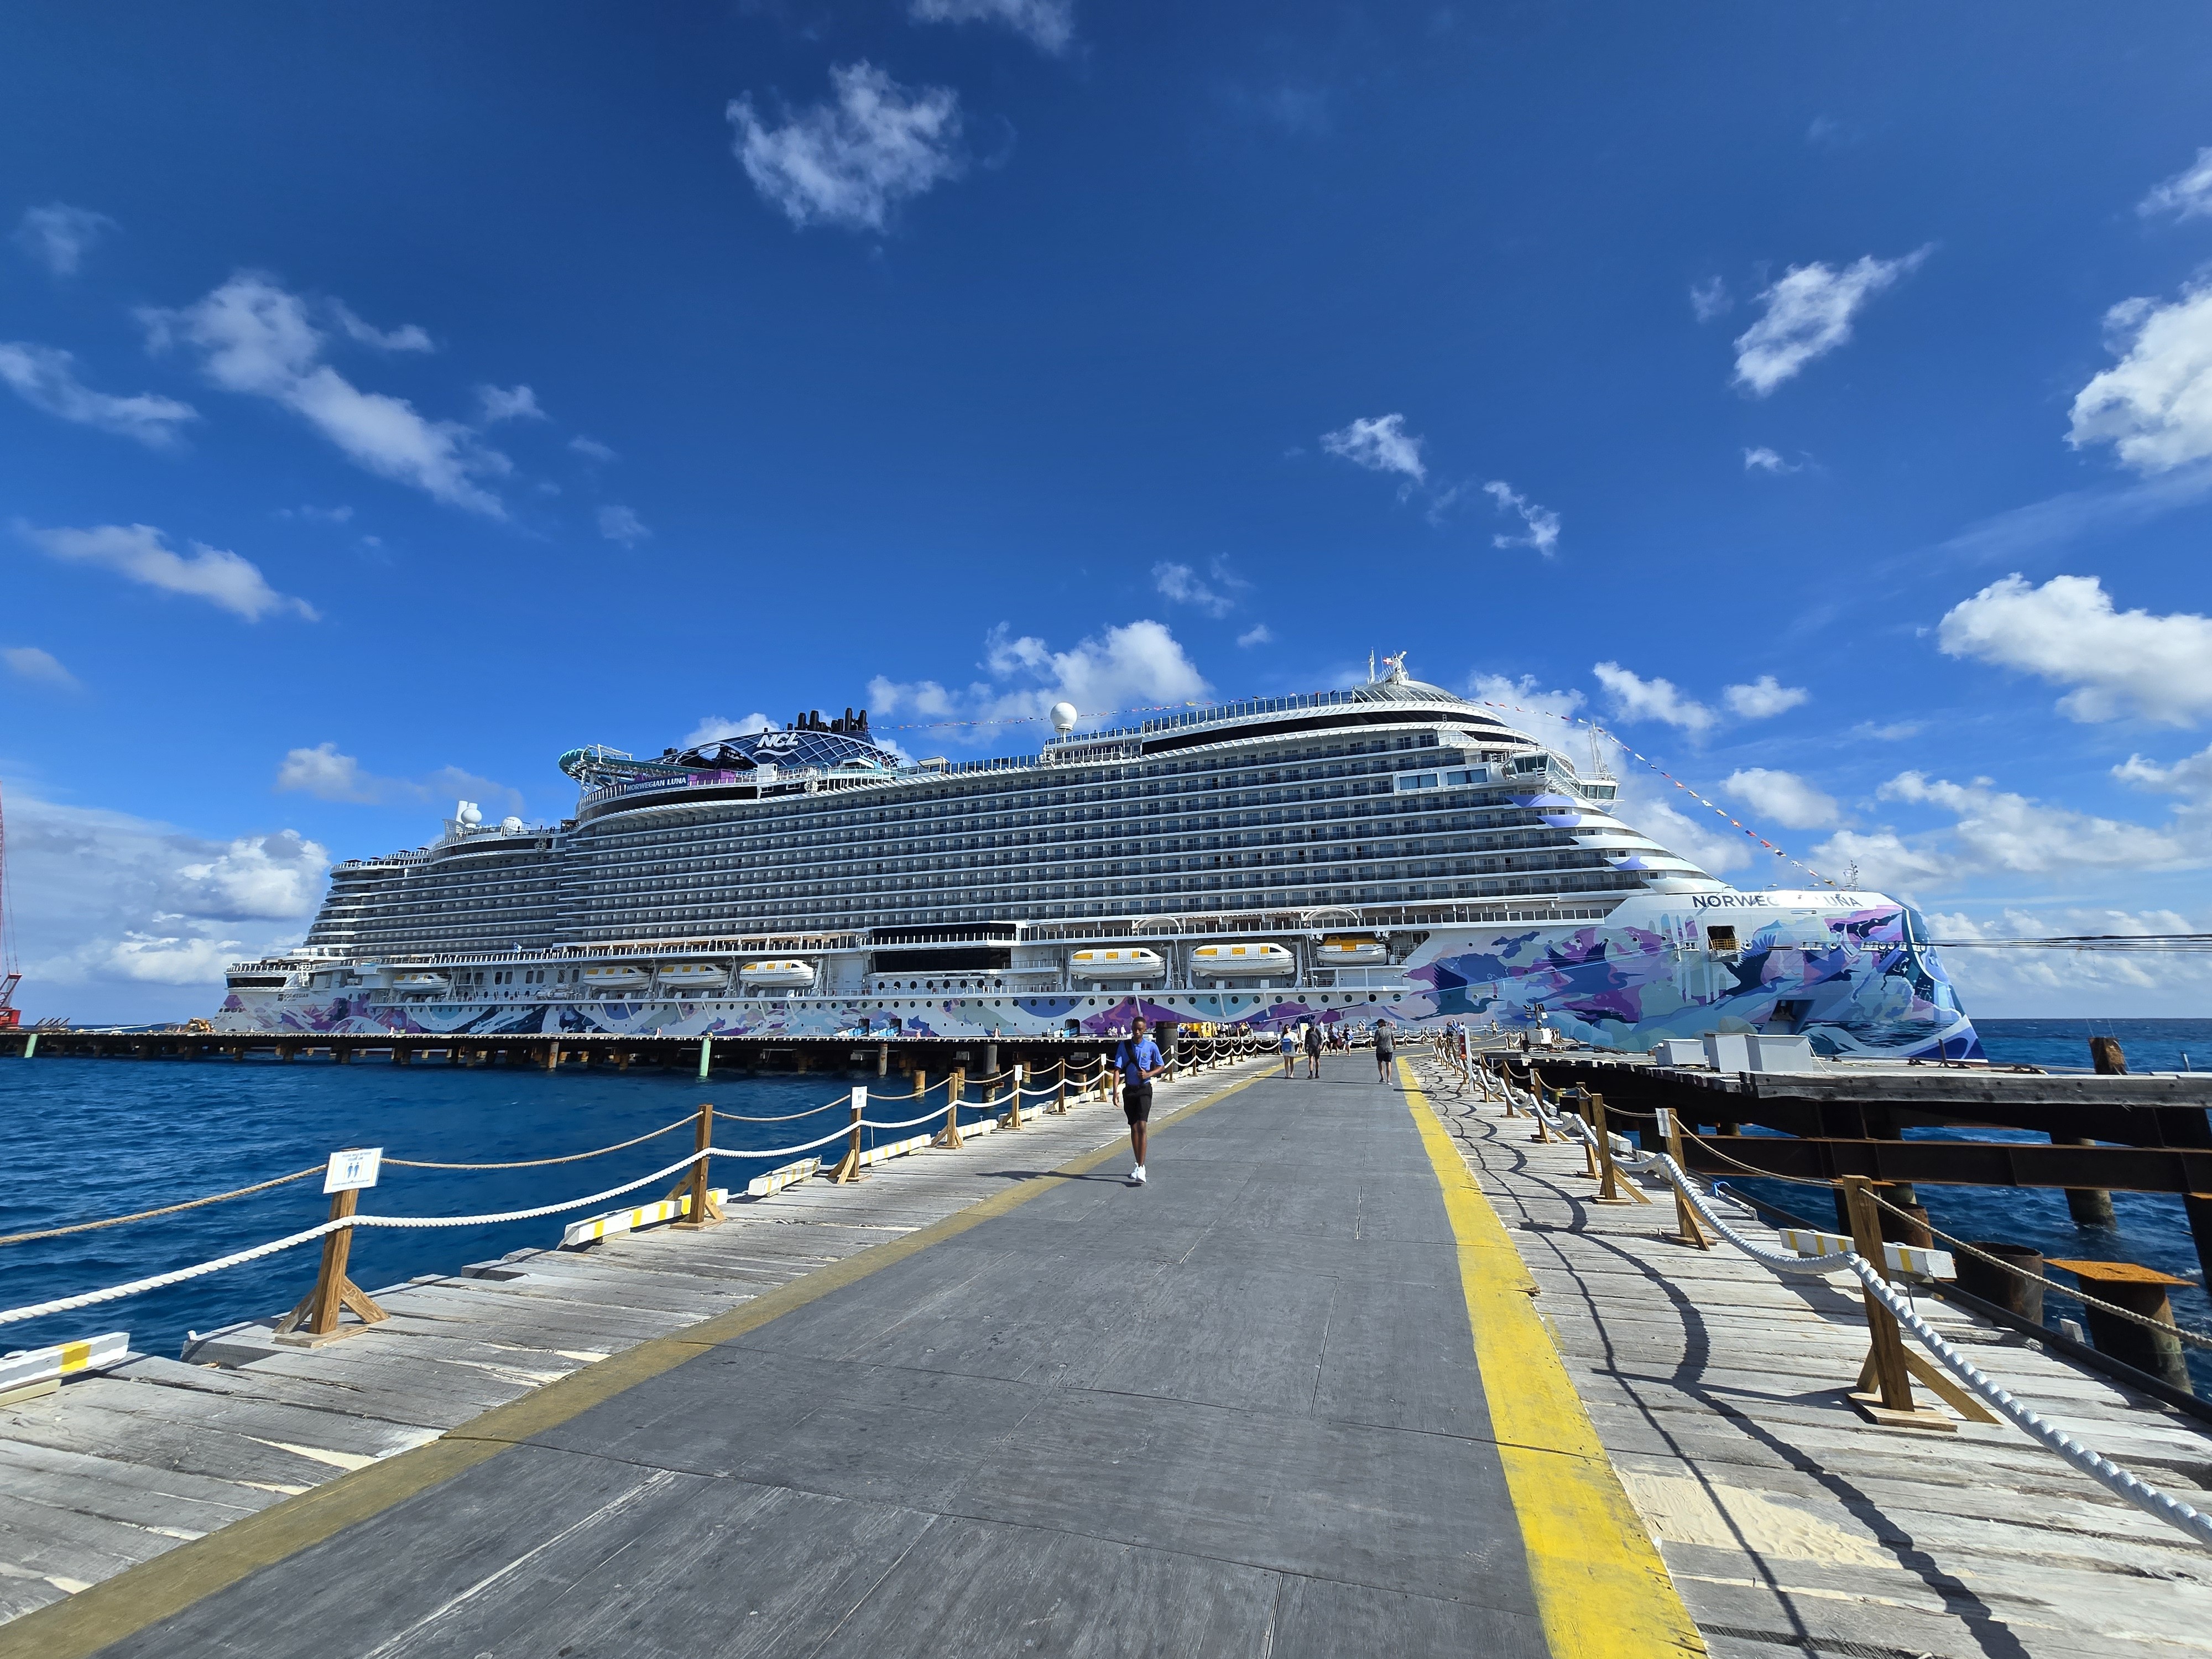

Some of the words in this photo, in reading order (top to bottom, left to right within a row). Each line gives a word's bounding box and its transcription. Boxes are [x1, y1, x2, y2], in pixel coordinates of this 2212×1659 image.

[757, 733, 798, 748] NCL
[627, 780, 665, 791] NORWEGIAN
[667, 777, 686, 785] LUNA
